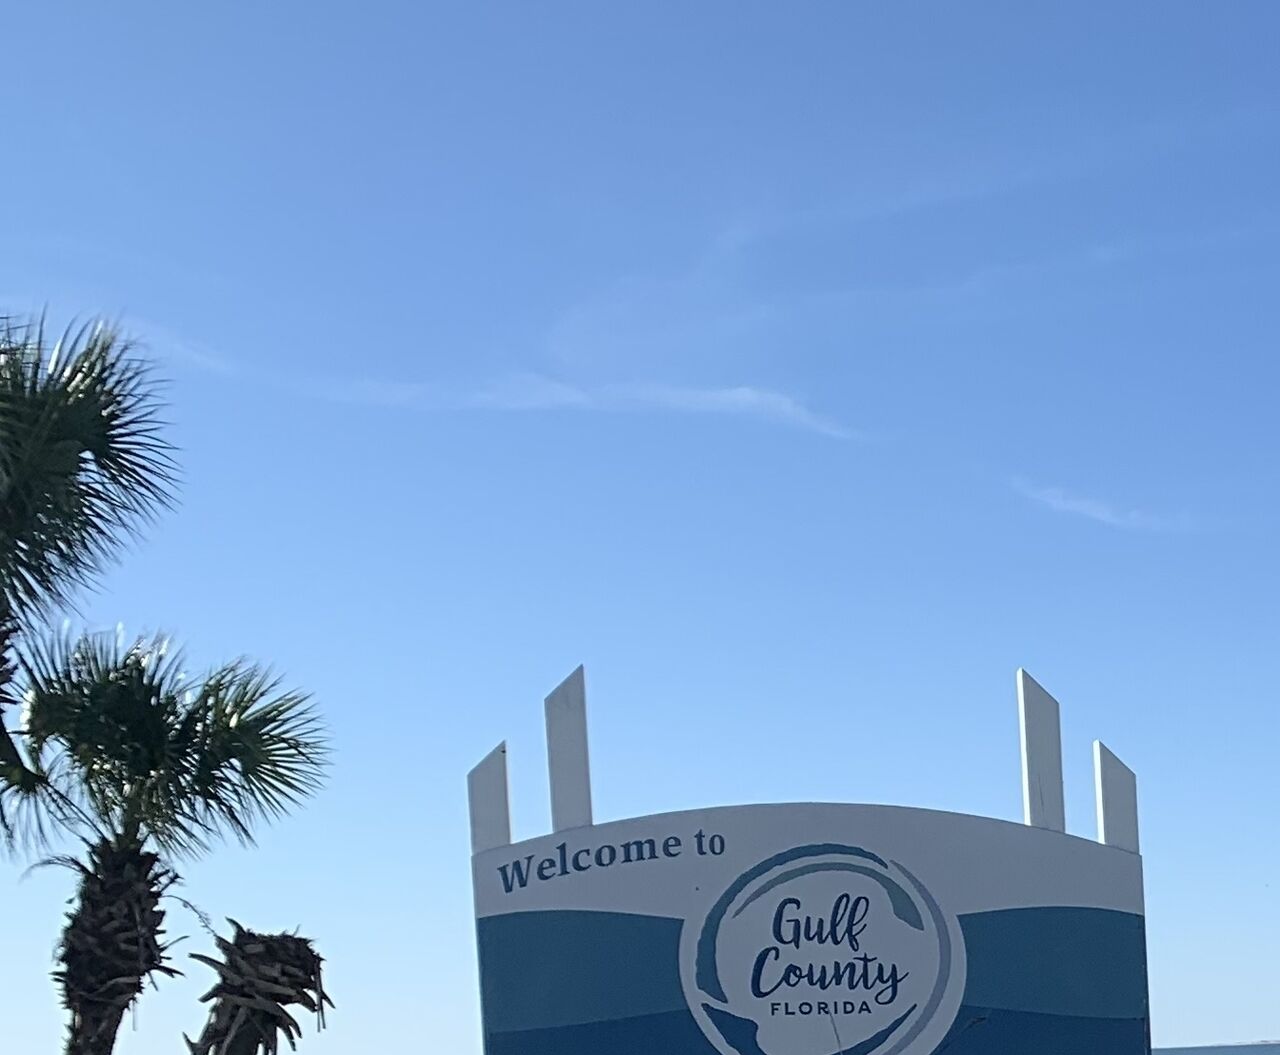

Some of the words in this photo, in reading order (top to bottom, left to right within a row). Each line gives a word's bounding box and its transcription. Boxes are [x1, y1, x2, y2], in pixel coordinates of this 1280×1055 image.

[497, 834, 682, 894] Welcome
[694, 829, 725, 856] to
[772, 892, 870, 952] Gulf
[751, 946, 909, 1005] County
[770, 1001, 872, 1017] FLORIDA
